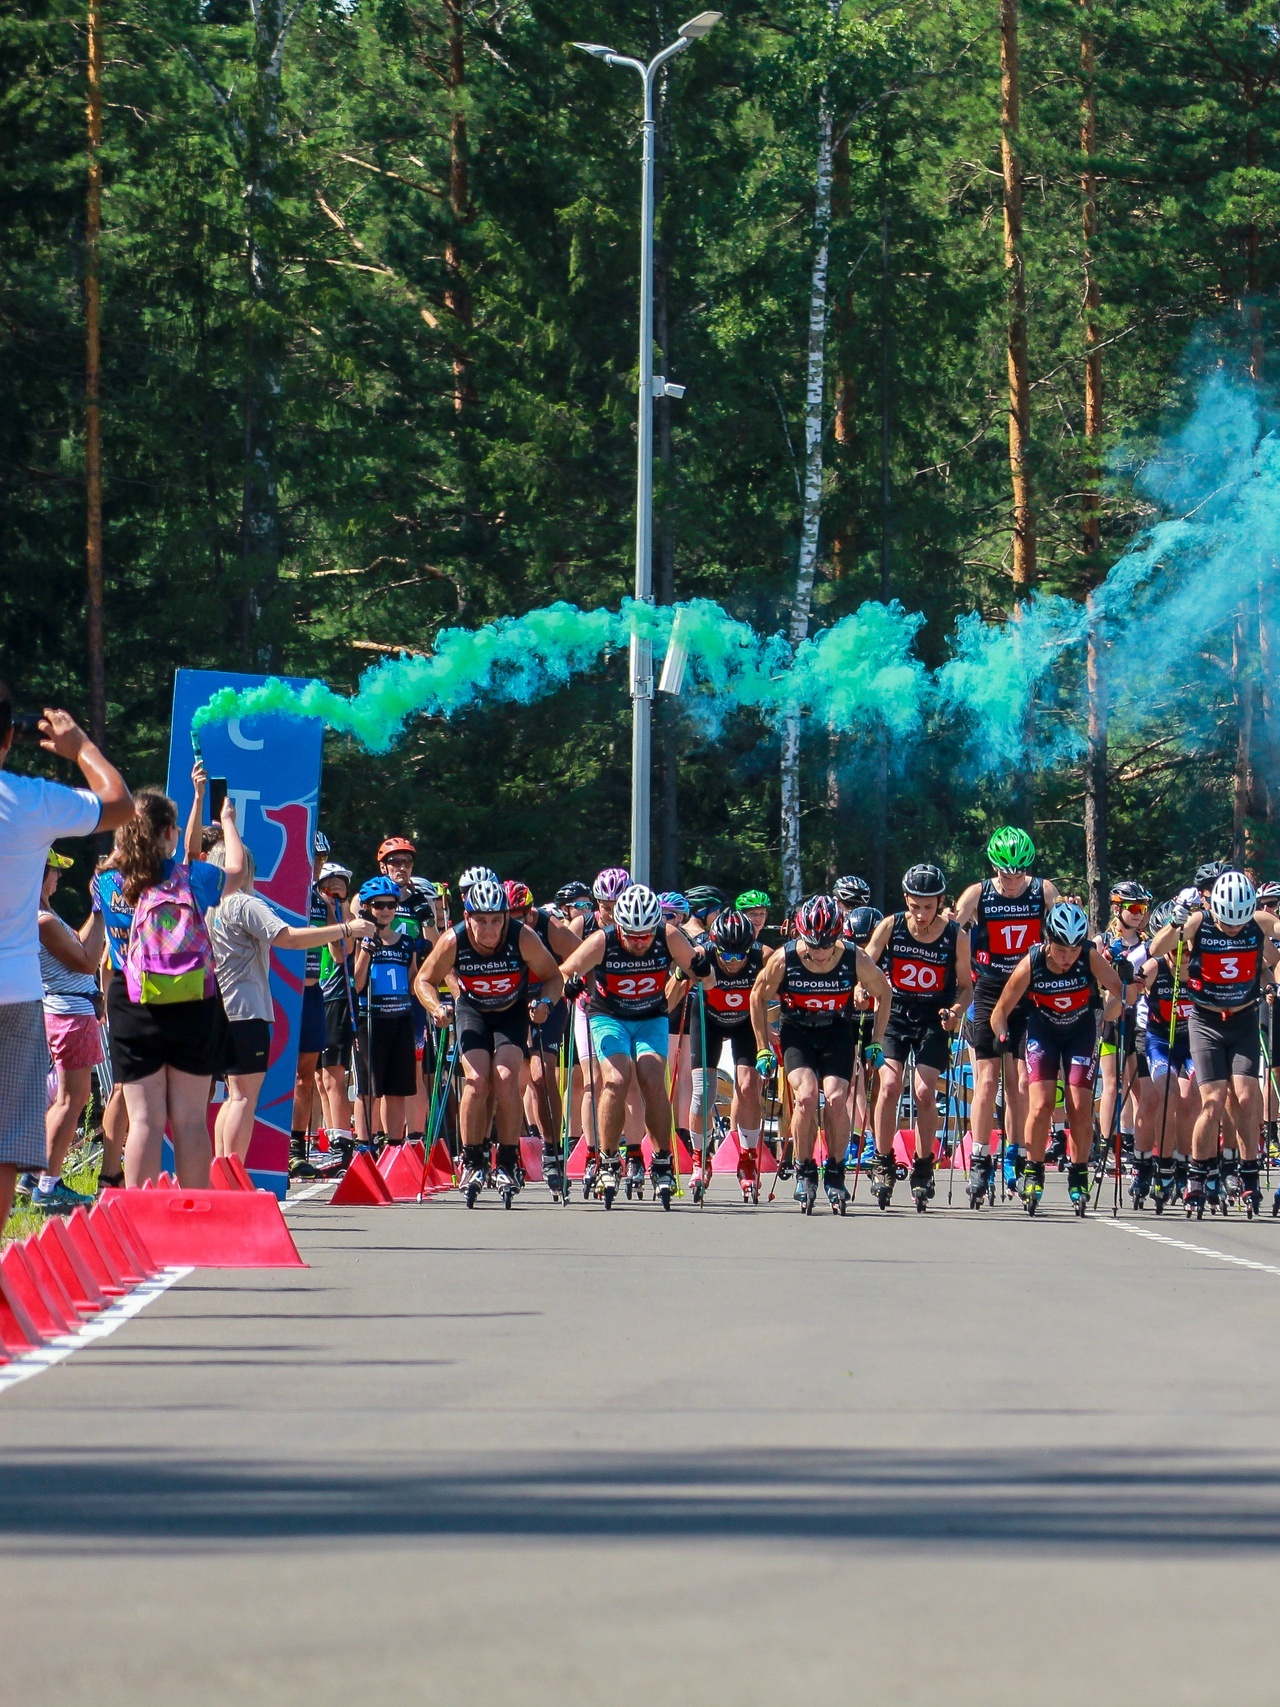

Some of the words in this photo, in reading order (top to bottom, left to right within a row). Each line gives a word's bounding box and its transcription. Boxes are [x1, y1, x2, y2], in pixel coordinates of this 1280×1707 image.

[984, 905, 1030, 914] ВОРОБЬИ
[1001, 925, 1028, 950] 17
[1201, 937, 1246, 946] ВОРОБЬИ
[893, 944, 938, 959] ВОРОБЬИ
[459, 961, 508, 970] ВОРОБЬИ
[605, 959, 655, 969] ВОРОБЬИ
[1219, 957, 1239, 979] 3
[386, 968, 397, 990] 1
[899, 963, 936, 988] 20
[472, 978, 512, 993] 23
[617, 977, 656, 995] 22
[788, 980, 839, 988] ВОРОБЬИ
[725, 993, 744, 1007] 6
